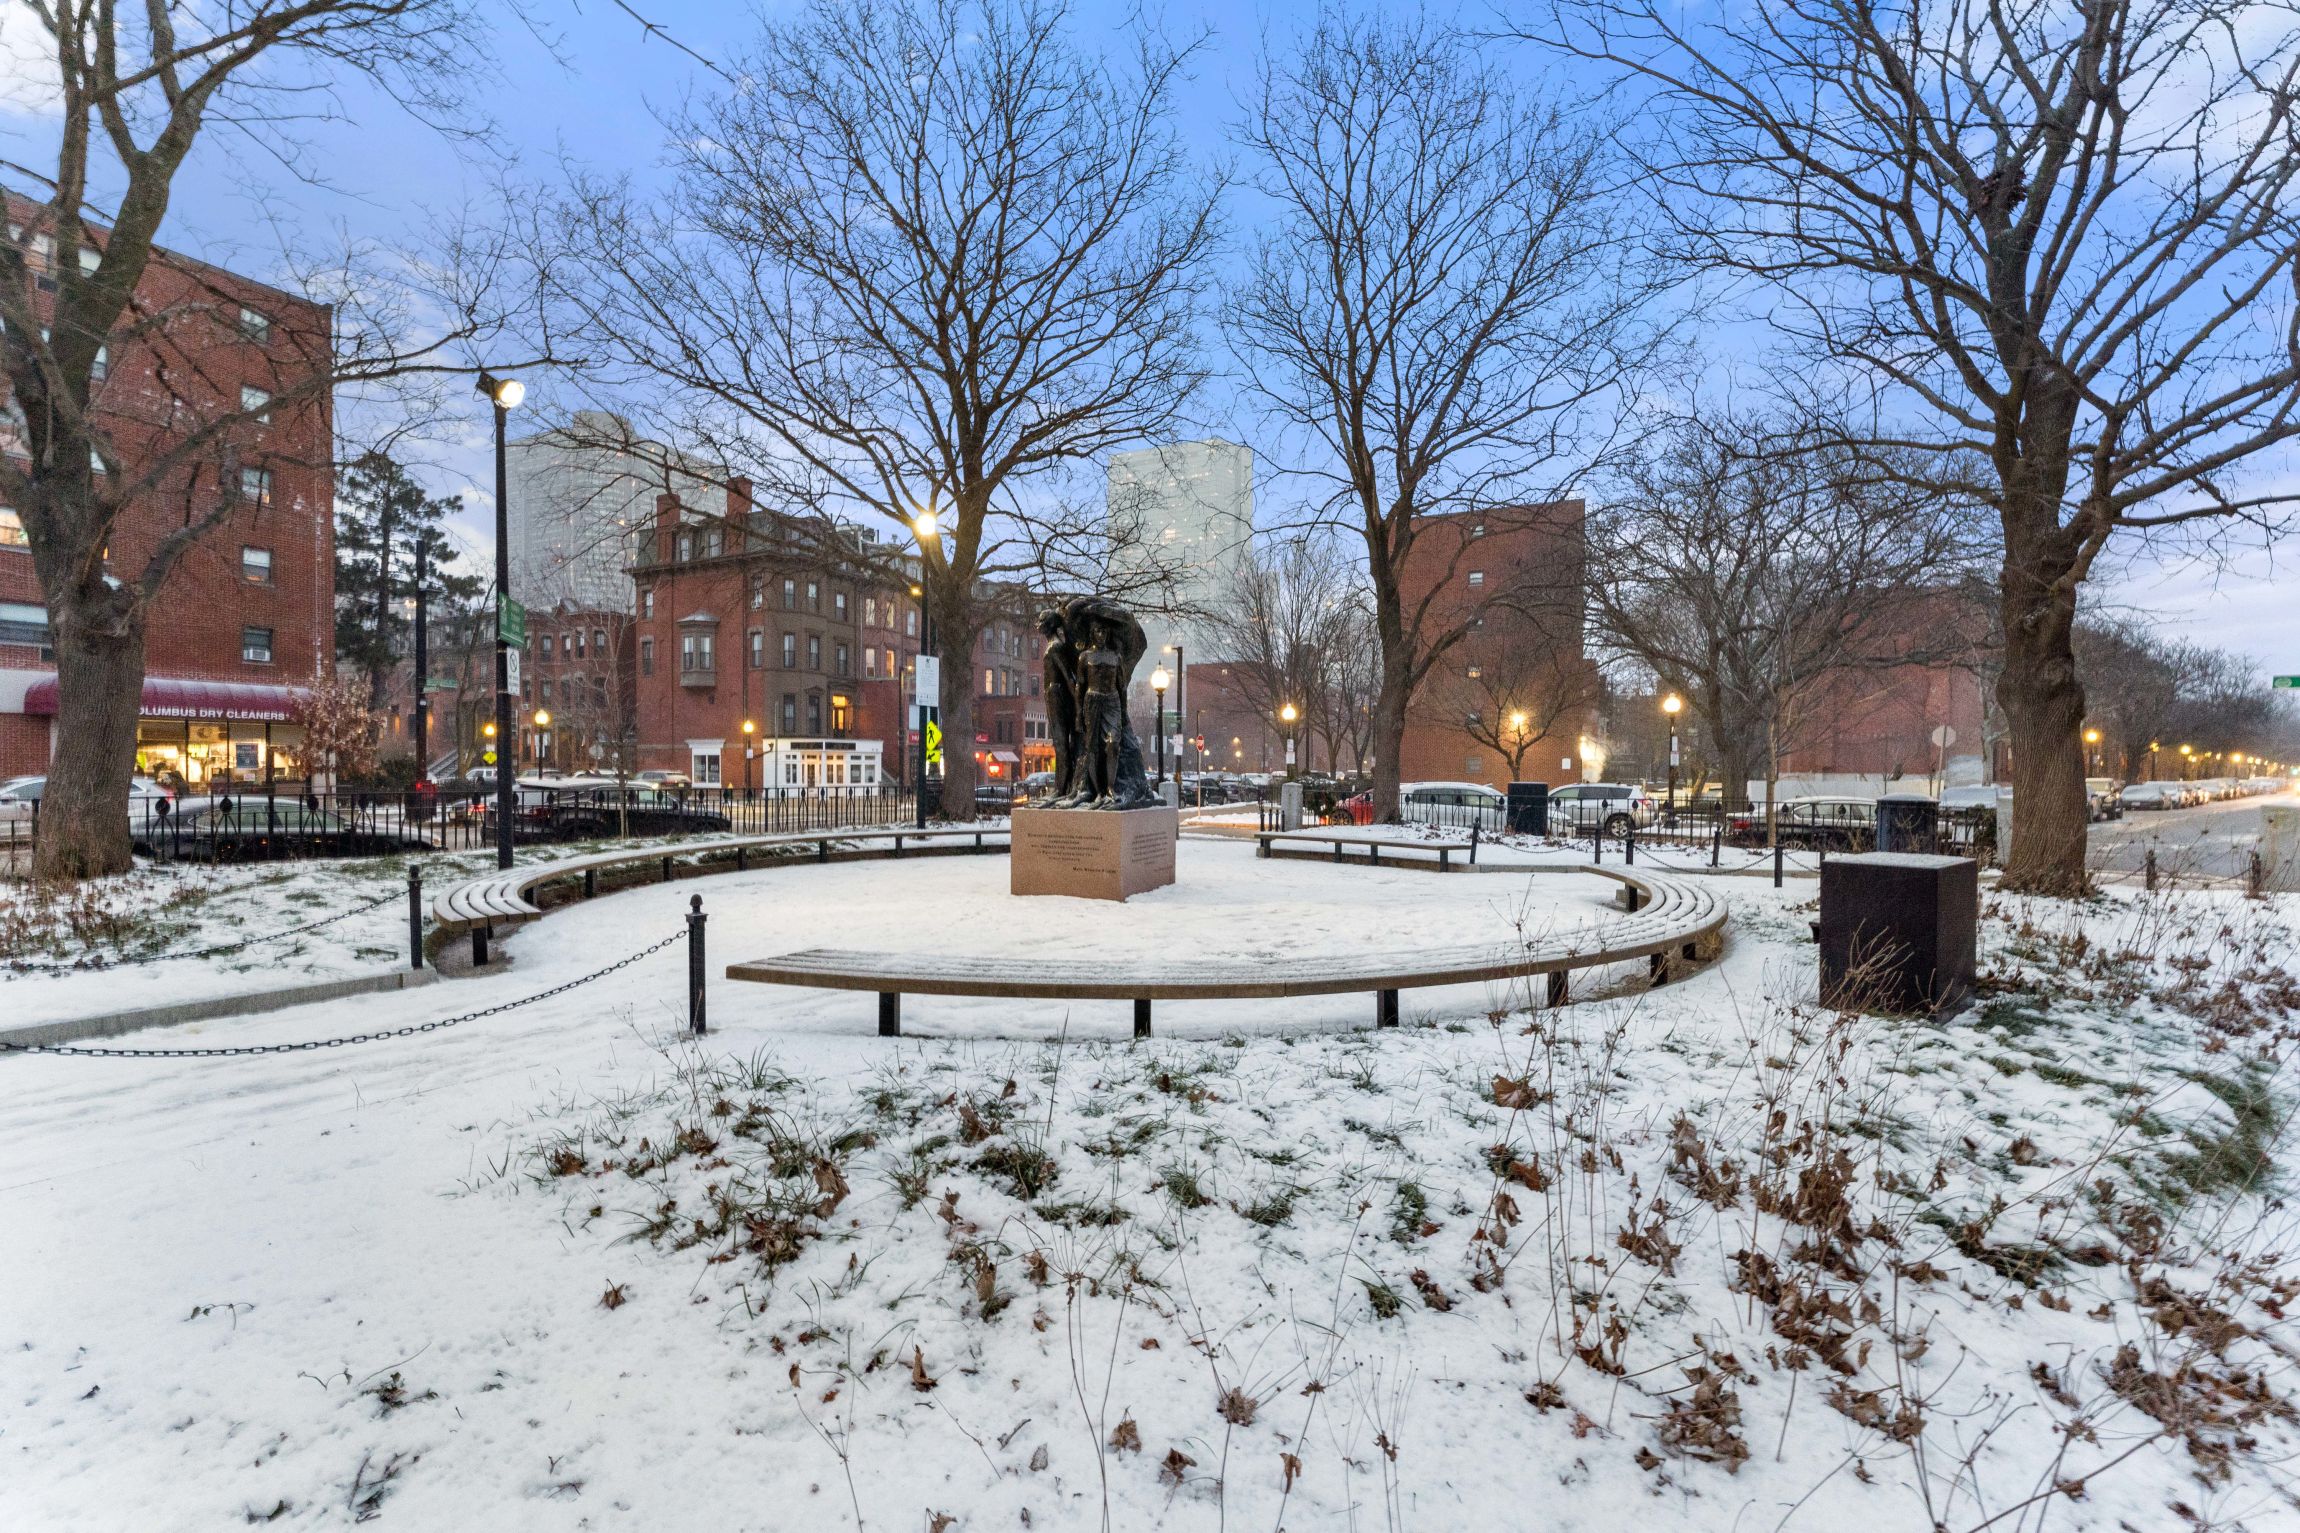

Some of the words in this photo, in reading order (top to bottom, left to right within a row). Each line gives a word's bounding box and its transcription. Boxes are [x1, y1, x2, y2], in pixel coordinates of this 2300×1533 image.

[138, 706, 196, 717] OLUMBUS
[199, 707, 224, 718] DRY
[227, 709, 285, 720] CLEANERS
